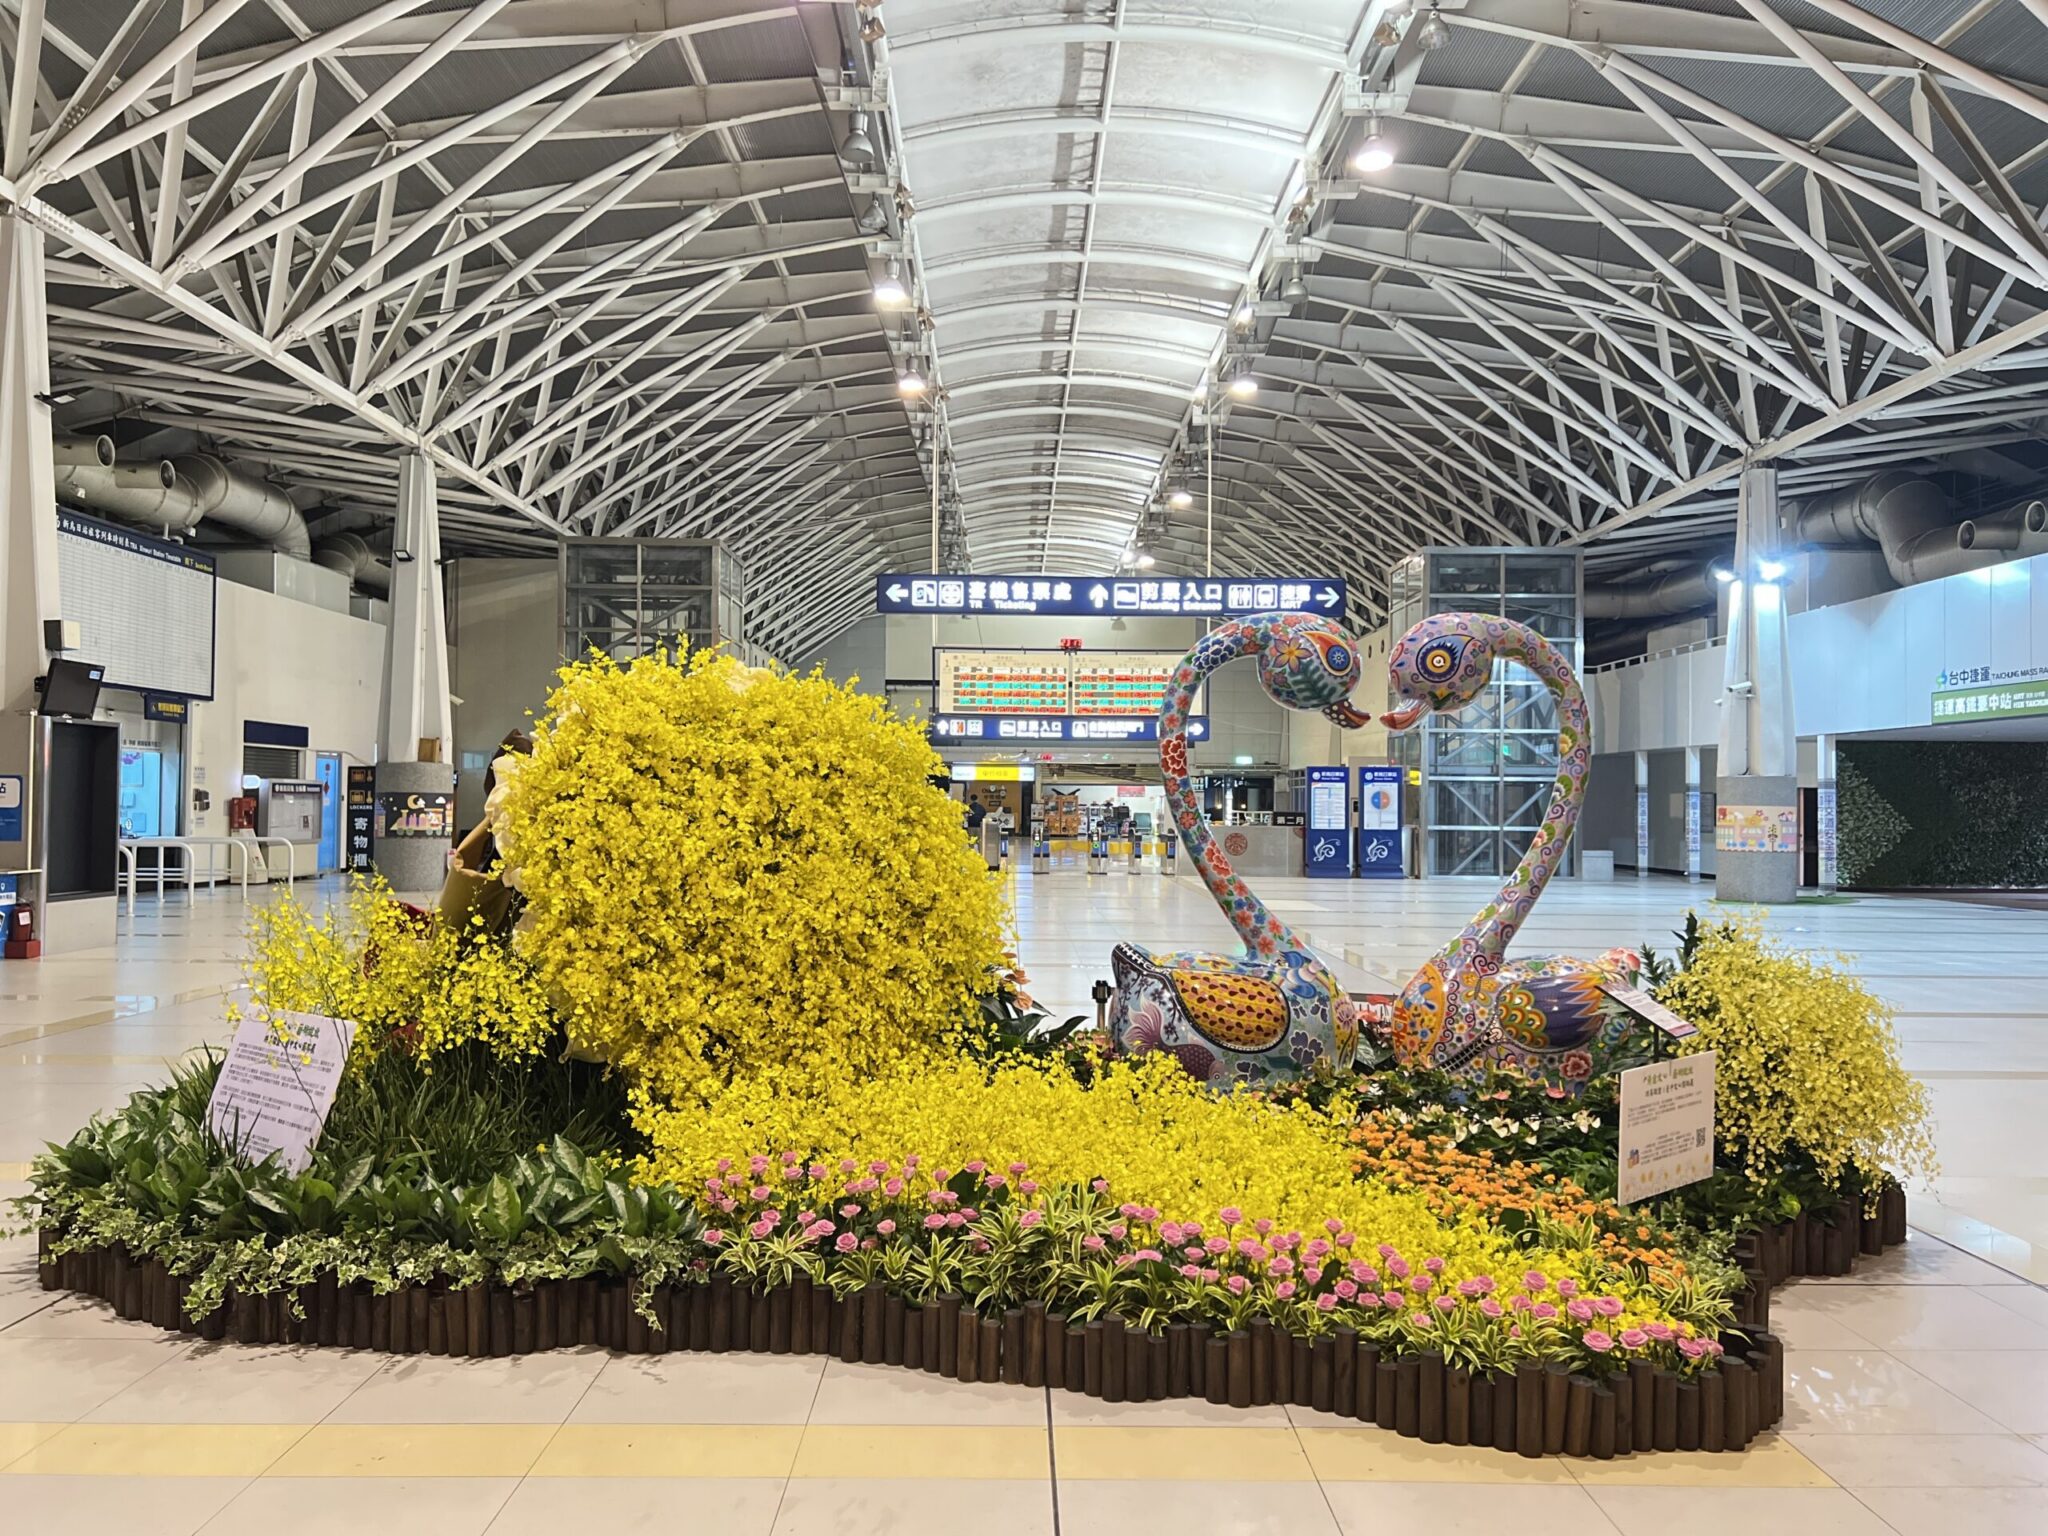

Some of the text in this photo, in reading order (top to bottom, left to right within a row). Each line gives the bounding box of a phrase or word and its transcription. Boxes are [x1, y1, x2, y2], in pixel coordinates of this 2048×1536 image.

[1140, 582, 1223, 600] 剪票入口
[994, 600, 1037, 611] Ticketing
[1183, 601, 1222, 610] Entrance
[1280, 600, 1301, 609] MRT
[1949, 666, 1990, 686] 台中捷運
[2020, 667, 2038, 677] MASS
[353, 817, 368, 867] 寄物櫃
